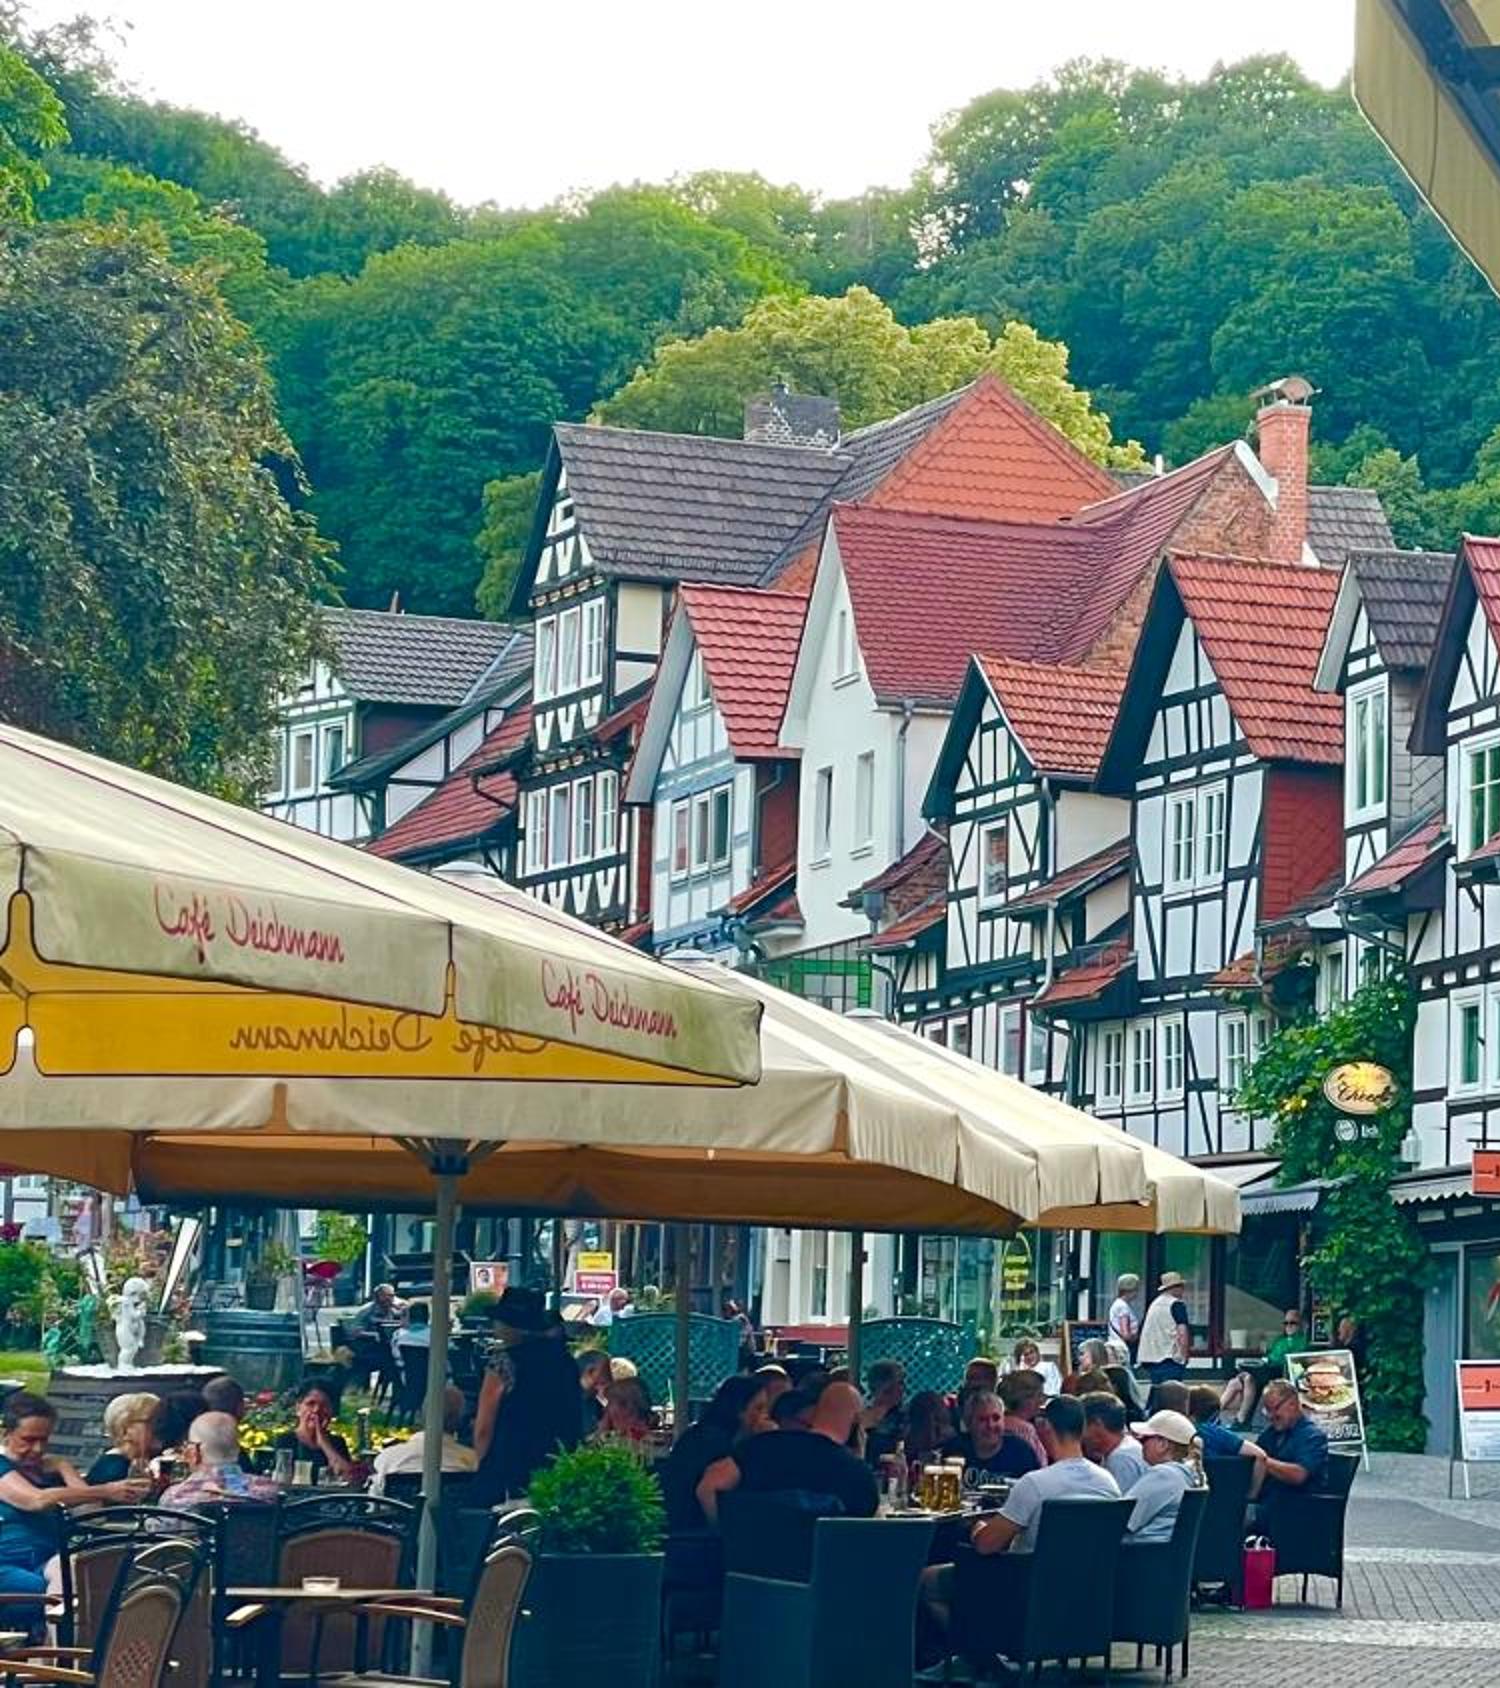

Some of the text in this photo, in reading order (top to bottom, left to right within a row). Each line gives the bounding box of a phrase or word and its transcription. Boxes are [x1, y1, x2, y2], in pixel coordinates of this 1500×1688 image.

[154, 883, 345, 963] Café Deichmann
[541, 959, 677, 1039] Café Deichmann
